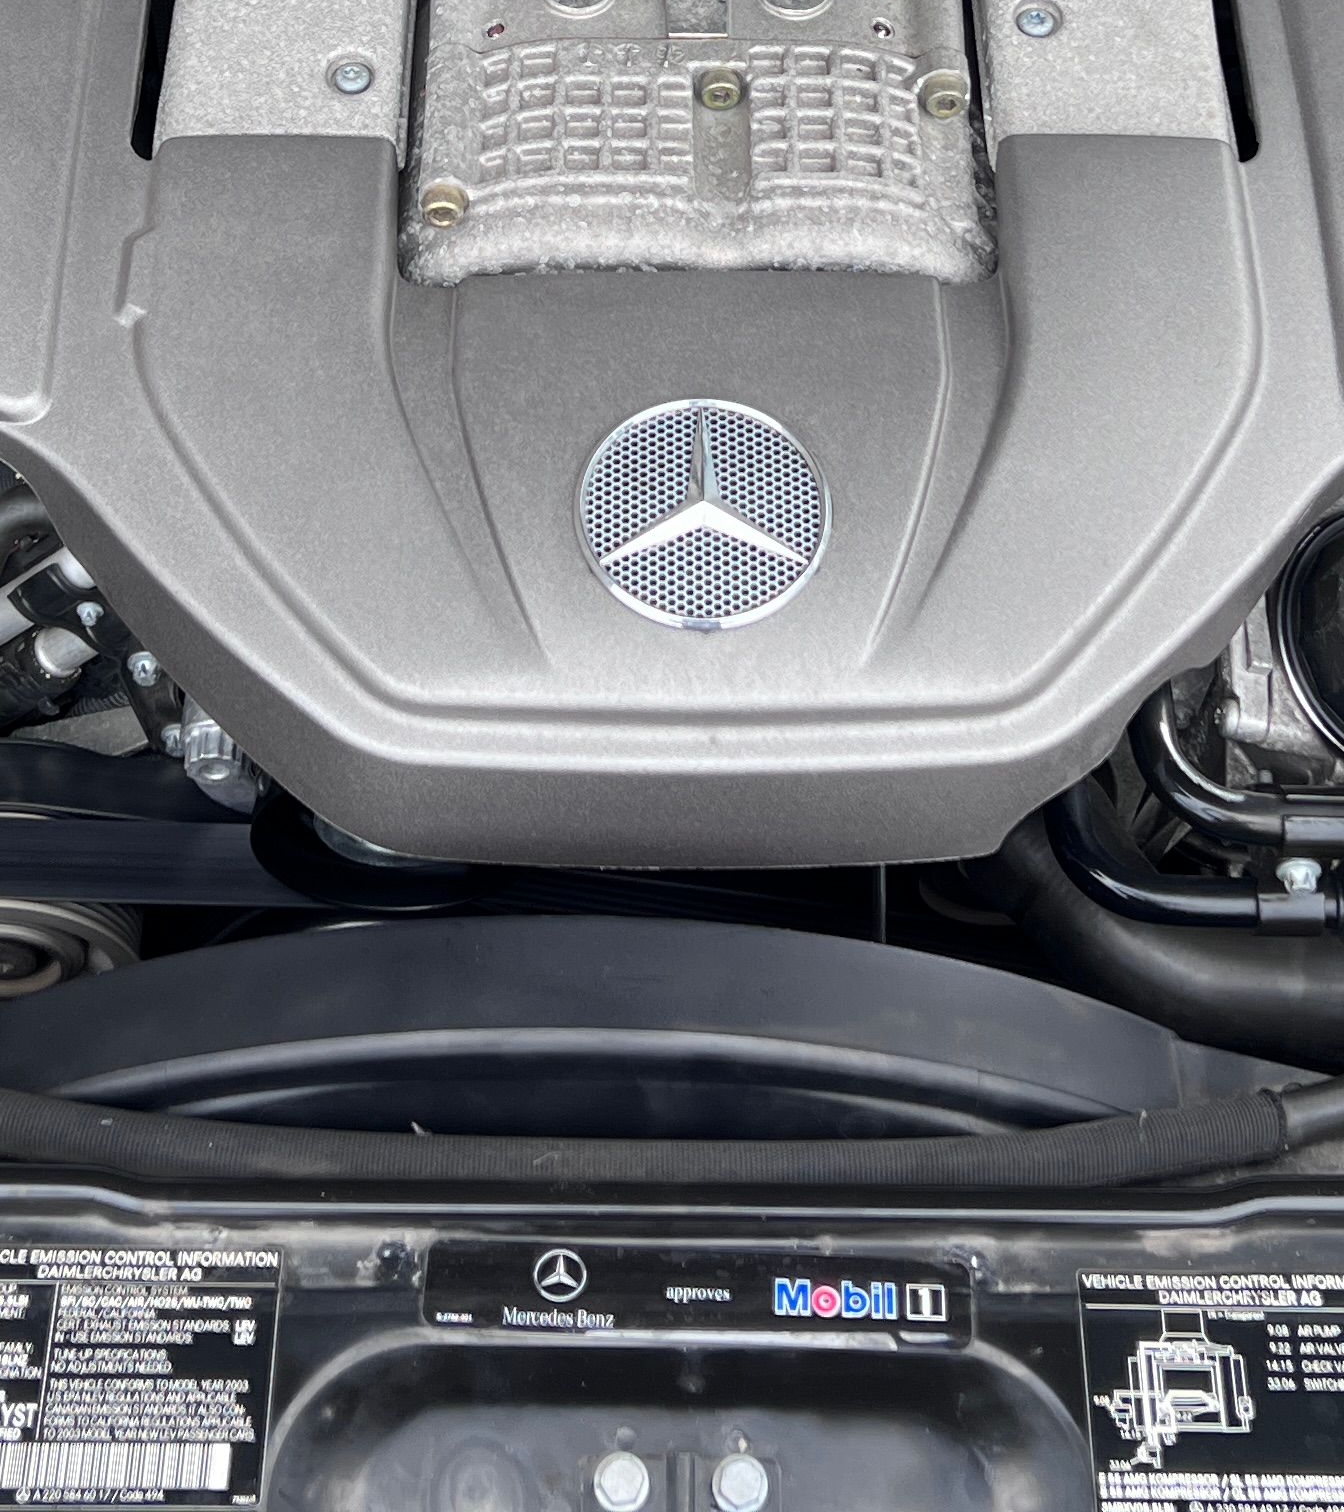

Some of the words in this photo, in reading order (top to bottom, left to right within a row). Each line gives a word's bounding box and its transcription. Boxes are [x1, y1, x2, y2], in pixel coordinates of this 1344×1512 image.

[30, 1249, 102, 1265] EMISSION
[105, 1250, 174, 1266] CONTROL
[177, 1251, 278, 1267] INFORMATION
[37, 1264, 177, 1281] DAIMLERCHRYSLER
[180, 1268, 202, 1281] AG
[1082, 1274, 1144, 1290] VEHICLE
[1145, 1274, 1217, 1290] EMISSION
[1219, 1274, 1291, 1290] CONTROL
[665, 1284, 731, 1305] approves
[773, 1277, 898, 1320] Mobil
[1158, 1290, 1298, 1306] DAIMLERCHRYSLER
[1300, 1291, 1324, 1307] AG
[502, 1306, 574, 1328] Mercedes
[577, 1308, 615, 1329] Benz
[234, 1320, 255, 1332] LEV
[1297, 1324, 1313, 1337] AIR
[1313, 1324, 1343, 1338] PUMP
[233, 1332, 255, 1345] LEV
[1299, 1342, 1315, 1355] AIR
[1301, 1359, 1334, 1373] CHECK
[49, 1378, 69, 1389] THIS
[70, 1379, 104, 1390] VEHICLE
[105, 1379, 155, 1390] CONFORMS
[169, 1379, 200, 1390] MODEL
[201, 1379, 224, 1390] YEAR
[225, 1380, 250, 1391] 2003
[165, 1391, 186, 1402] AND
[197, 1404, 222, 1414] ALSO
[57, 1427, 81, 1439] 2003
[81, 1428, 112, 1439] MODEL
[114, 1428, 136, 1439] YEAR
[137, 1428, 158, 1439] NEW
[1123, 1472, 1147, 1486] AMG
[1148, 1472, 1219, 1487] KOMPRESSOR
[1260, 1474, 1285, 1488] AMG
[42, 1489, 62, 1501] 220
[119, 1490, 144, 1501] Code
[1124, 1486, 1149, 1500] AMG
[1150, 1486, 1222, 1501] KOMPRESSOR
[1263, 1488, 1288, 1502] AMG
